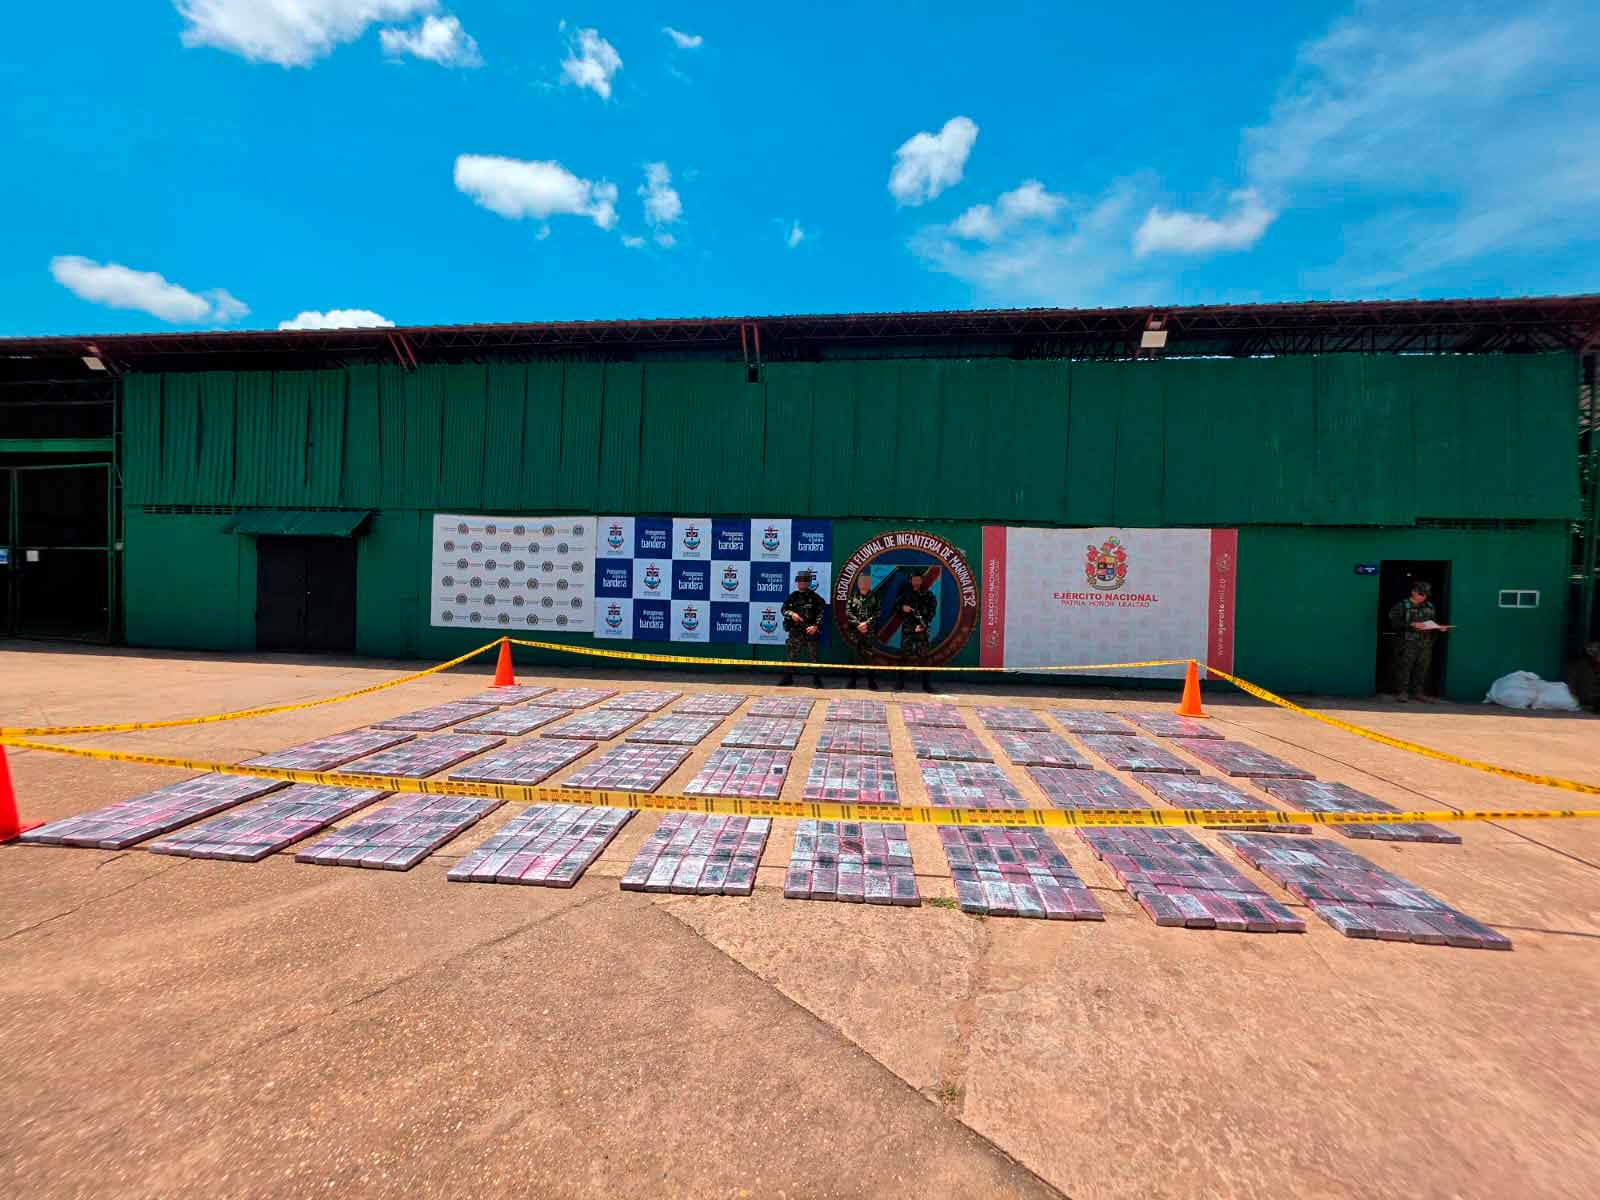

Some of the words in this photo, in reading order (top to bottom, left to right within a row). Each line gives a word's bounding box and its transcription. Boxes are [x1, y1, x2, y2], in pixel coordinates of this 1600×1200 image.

[641, 539, 666, 550] bandera
[718, 540, 744, 551] bandera
[798, 541, 824, 552] bandera
[836, 561, 860, 601] BATALLON
[853, 541, 885, 565] FLUVIAL
[883, 535, 896, 548] DE
[896, 534, 942, 554] INFANTERIA
[940, 546, 954, 561] DE
[949, 555, 973, 587] MARINA
[602, 577, 627, 588] bandera
[678, 579, 704, 590] bandera
[757, 581, 783, 592] bandera
[1053, 592, 1102, 600] EJERCITO
[1105, 593, 1158, 602] NACIONAL
[639, 618, 664, 629] bandera
[716, 621, 742, 632] bandera
